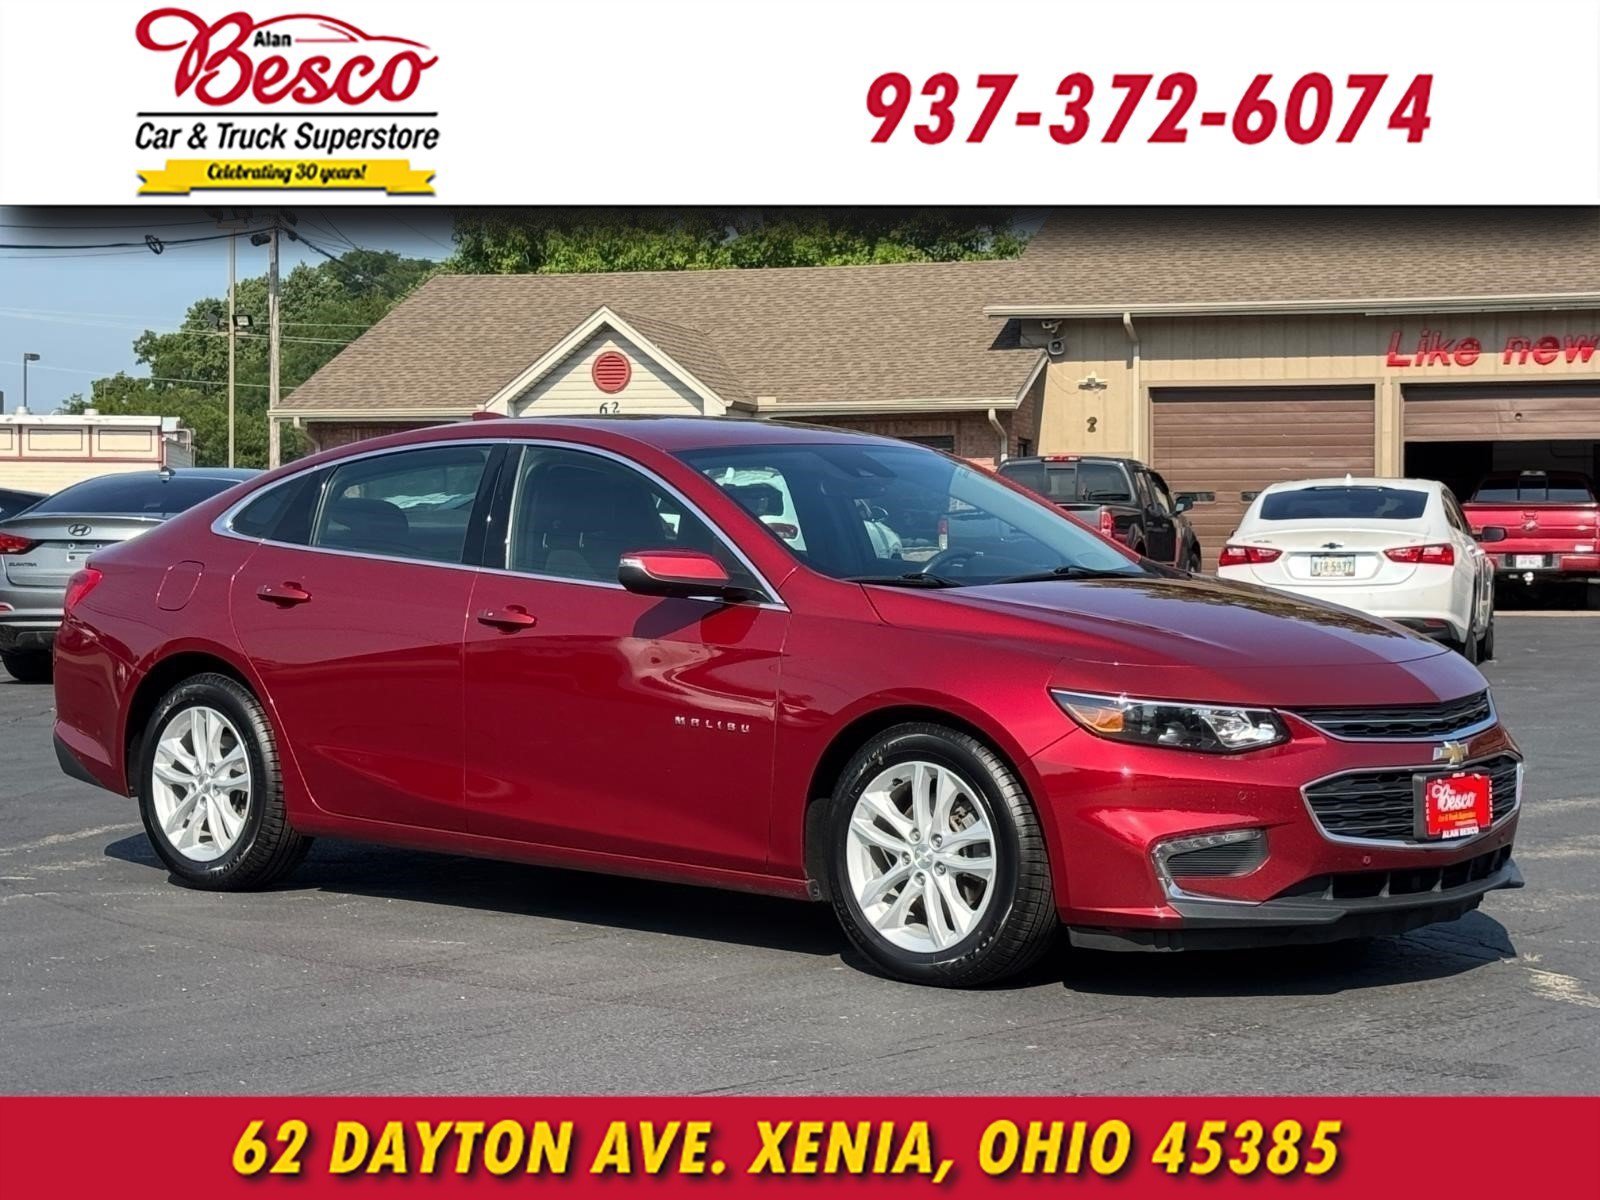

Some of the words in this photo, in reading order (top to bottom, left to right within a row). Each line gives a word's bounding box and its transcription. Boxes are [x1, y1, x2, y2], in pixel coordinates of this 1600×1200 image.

[1386, 327, 1482, 367] Like
[1503, 334, 1600, 366] new
[599, 401, 621, 415] 62
[674, 715, 751, 734] MALIBU
[1431, 783, 1478, 813] Besco
